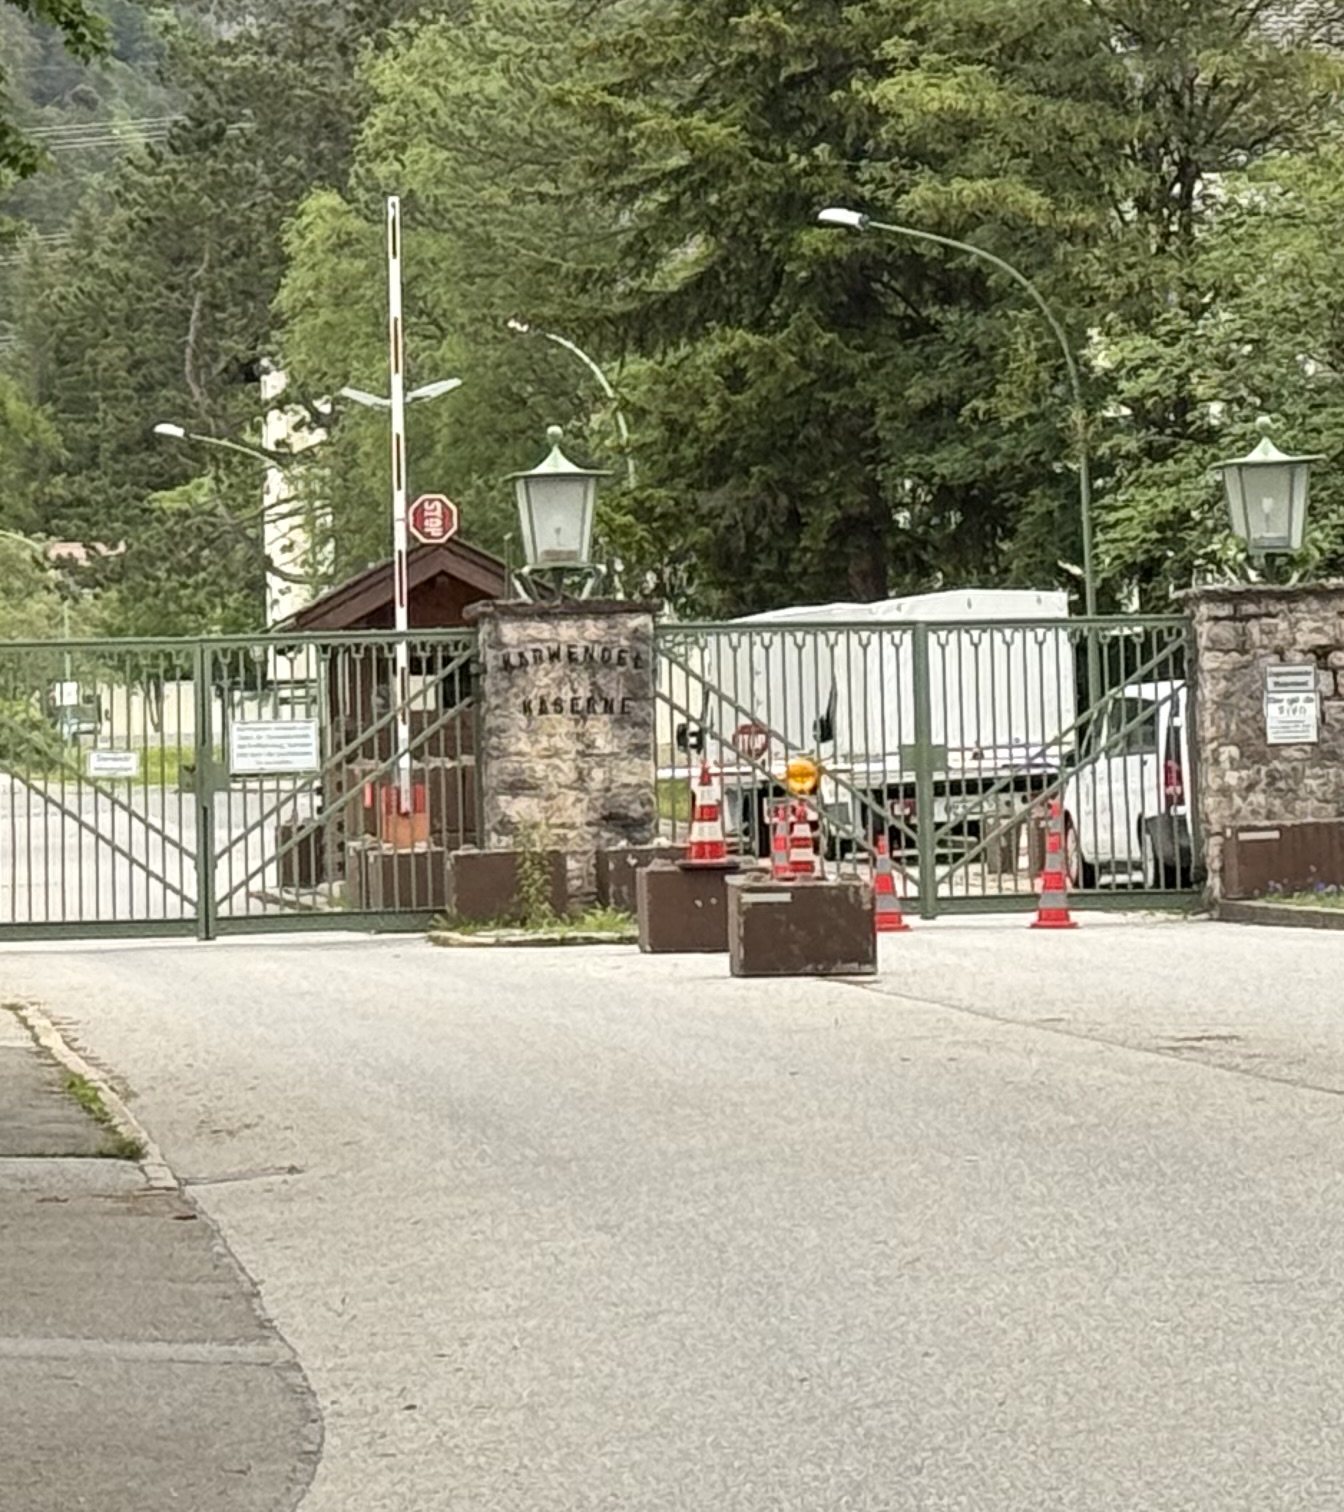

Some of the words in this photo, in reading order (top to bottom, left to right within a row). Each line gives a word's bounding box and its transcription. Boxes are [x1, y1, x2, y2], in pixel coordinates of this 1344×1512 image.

[423, 500, 444, 537] STOP
[502, 643, 644, 672] KARWENDEL
[522, 695, 632, 716] KASERNE
